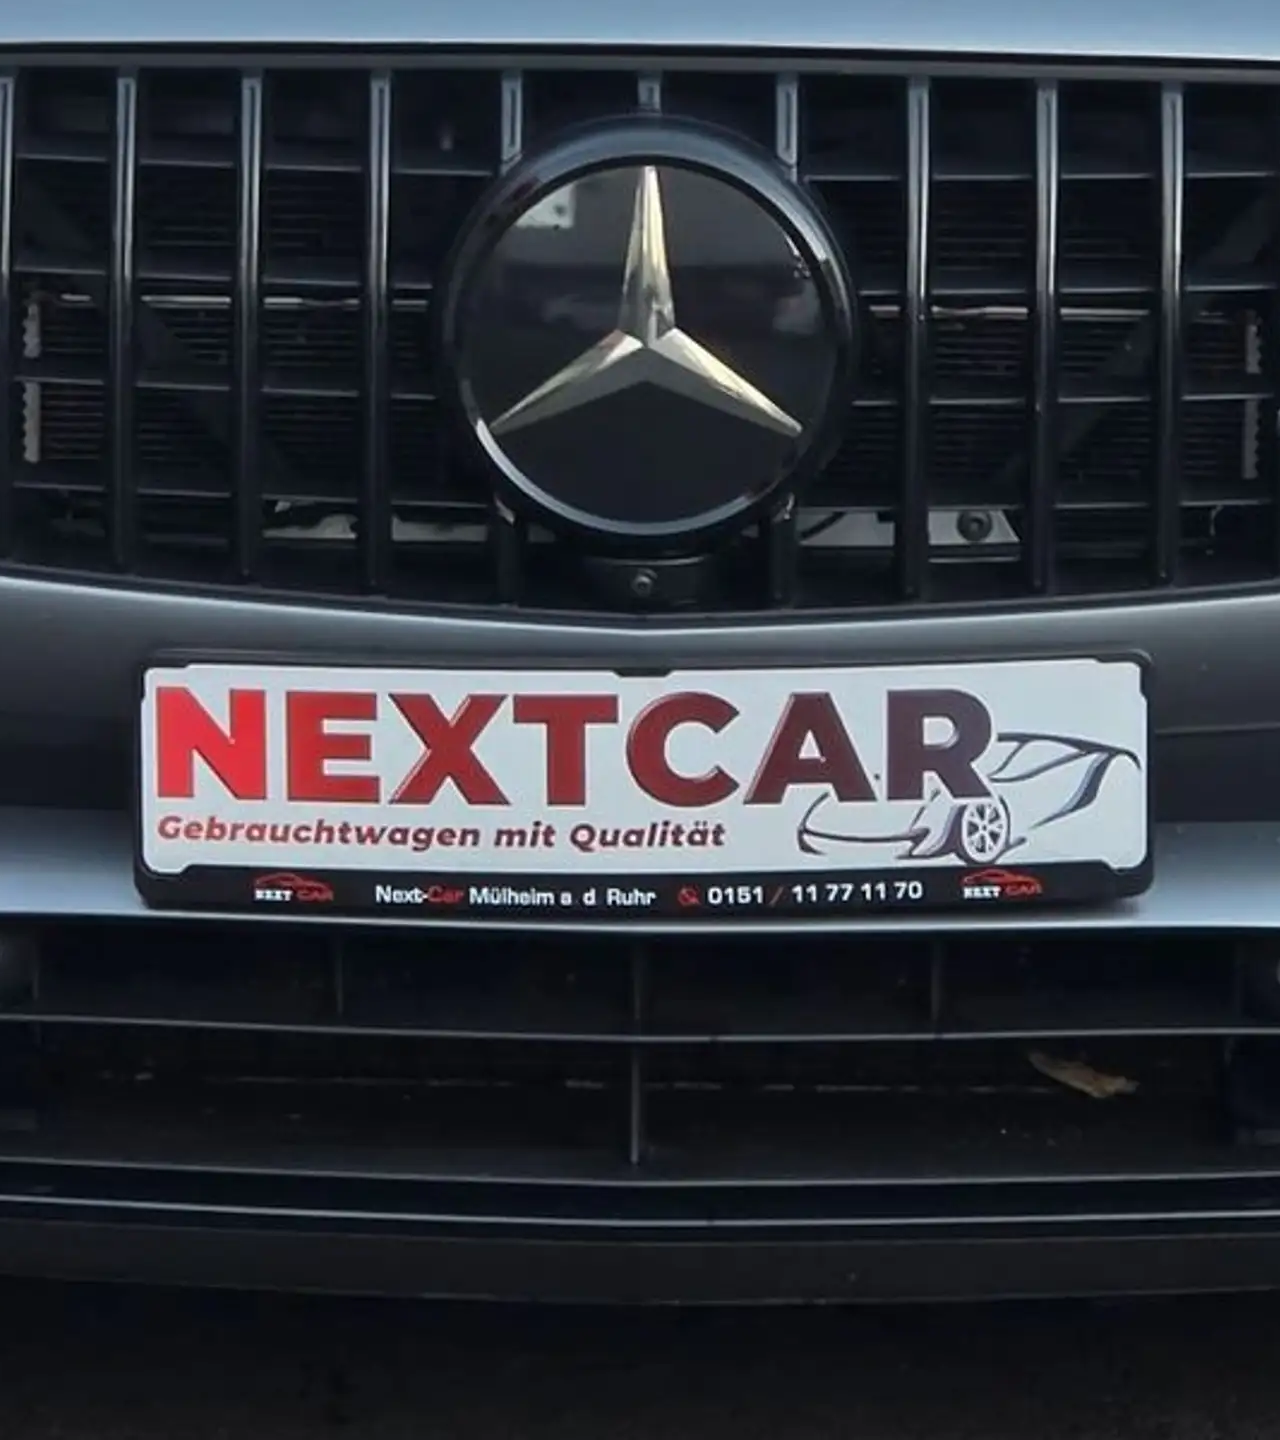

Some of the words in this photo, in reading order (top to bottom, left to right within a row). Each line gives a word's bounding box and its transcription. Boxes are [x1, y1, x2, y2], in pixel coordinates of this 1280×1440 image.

[155, 685, 993, 808] NEXTCAR
[157, 815, 481, 853] Gebrauchtwagen
[494, 821, 556, 848] mit
[570, 821, 726, 853] Qualität
[375, 884, 464, 904] Next-Car
[469, 886, 555, 906] Mülheim
[606, 887, 657, 907] Ruhr
[707, 885, 764, 905] 0151
[791, 883, 818, 903] 11
[825, 882, 854, 902] 77
[860, 881, 887, 901] 11
[893, 879, 924, 900] 70
